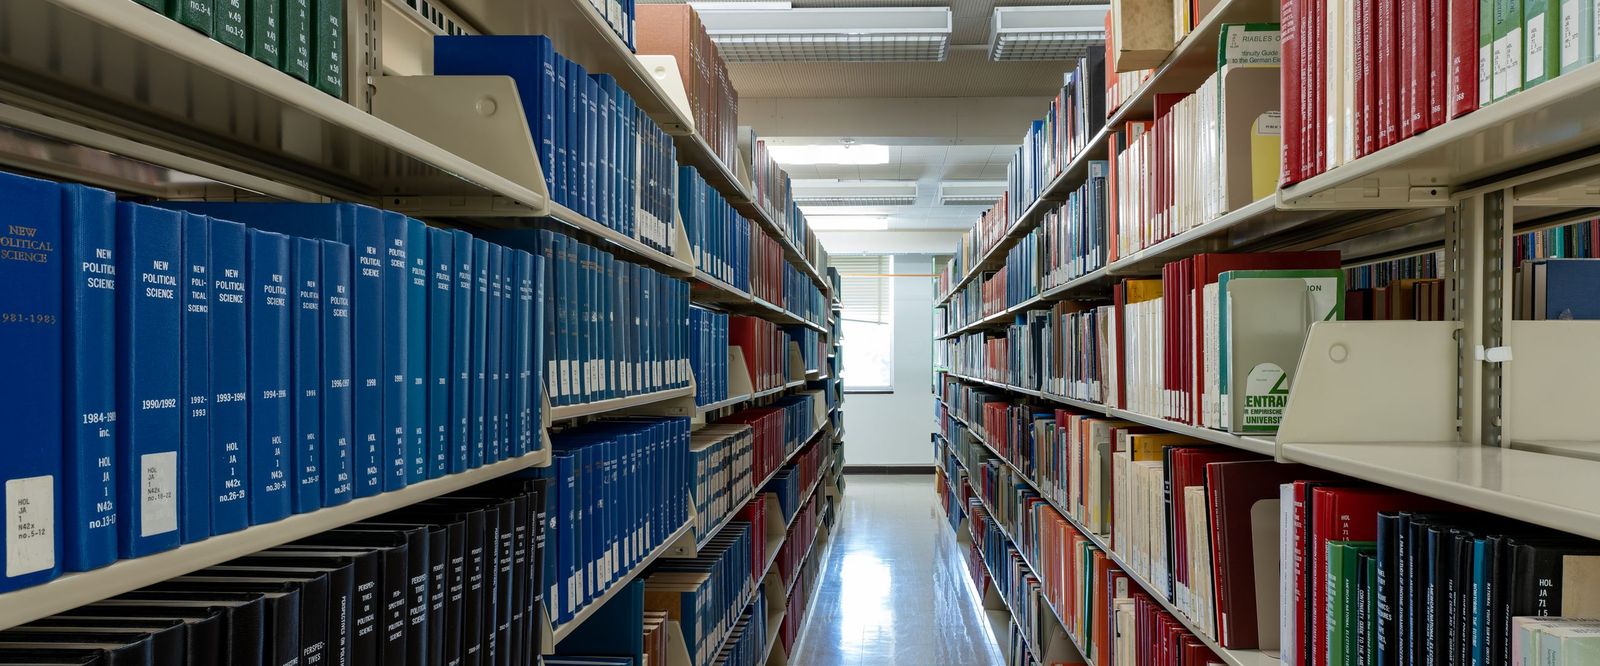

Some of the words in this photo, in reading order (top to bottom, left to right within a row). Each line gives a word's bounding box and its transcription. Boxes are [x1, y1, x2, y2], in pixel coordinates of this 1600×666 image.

[190, 1, 211, 16] no.3-4
[228, 11, 242, 23] v.49
[225, 25, 244, 38] no.1-2
[9, 225, 37, 237] NEW
[96, 249, 112, 259] NEW
[366, 246, 377, 255] NEW
[1, 250, 48, 263] SCIENCE
[360, 256, 381, 267] POLITICAL
[153, 260, 169, 271] NEW
[193, 265, 205, 274] NEW
[225, 269, 239, 278] NEW
[362, 268, 380, 278] SCIENCE
[88, 277, 115, 290] SCIENCE
[143, 273, 177, 286] POLITICAL
[191, 278, 207, 287] POLI-
[272, 274, 283, 283] NEW
[215, 280, 245, 292] POLITICAL
[336, 285, 346, 294] NEW
[146, 287, 174, 299] SCIENCE
[192, 291, 206, 300] TICAL
[219, 293, 243, 304] SCIENCE
[0, 313, 56, 325] 981-1983
[216, 392, 246, 403] 1993-1994
[142, 399, 177, 410] 1990/1992
[192, 409, 206, 417] 1993
[99, 428, 110, 437] inc.
[367, 433, 376, 442] HOL
[272, 436, 282, 445] HOL
[338, 438, 347, 446] HOL
[226, 442, 239, 451] HOL
[275, 448, 281, 456] JA
[98, 458, 111, 468] HOL
[229, 455, 237, 464] JA
[102, 472, 110, 482] JA
[225, 479, 241, 488] N42x
[97, 501, 113, 512] N42x
[18, 522, 35, 531] N42x
[18, 528, 46, 540] no.5-12
[1539, 579, 1552, 587] HOL
[1539, 589, 1547, 597] JA
[304, 641, 325, 657] PERSPEC-
[308, 653, 321, 665] TIVES
